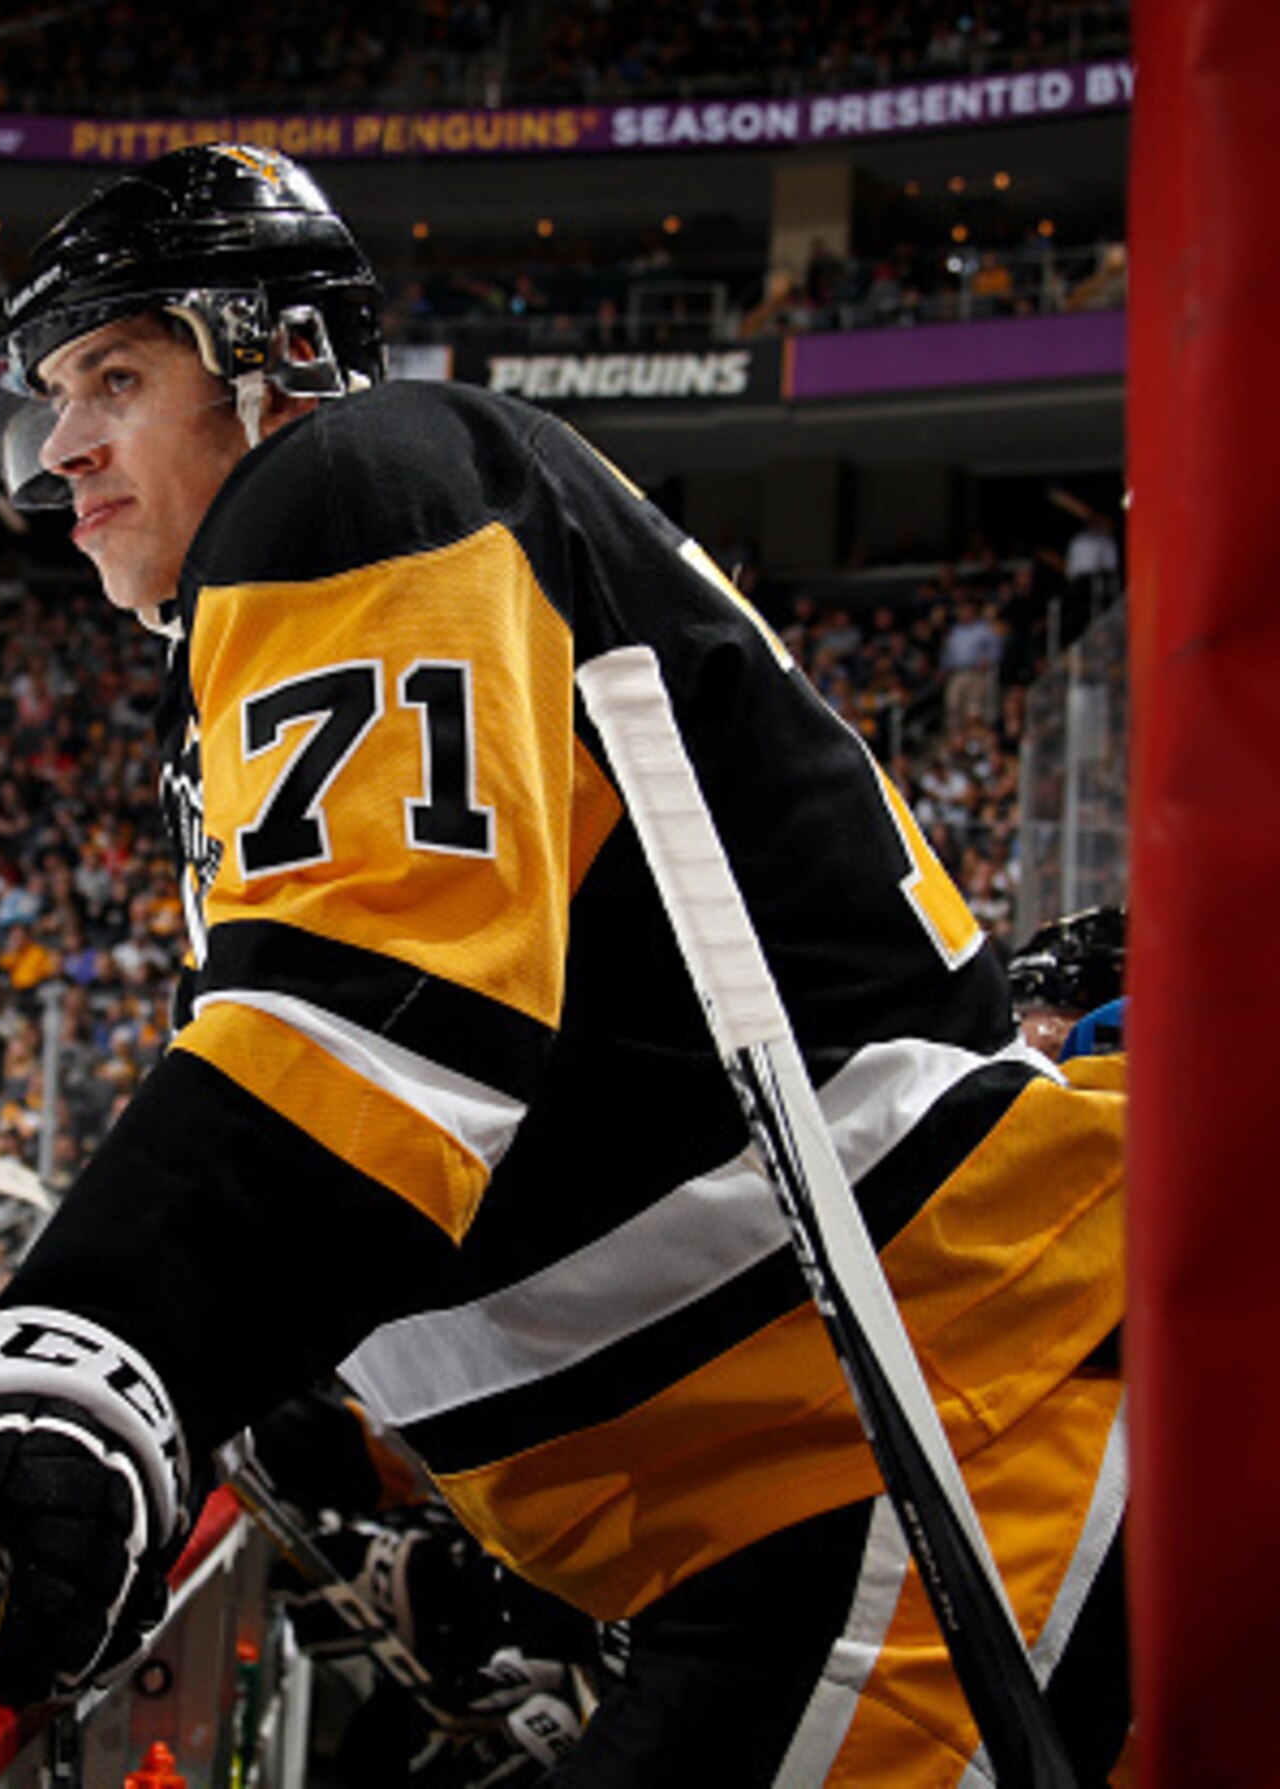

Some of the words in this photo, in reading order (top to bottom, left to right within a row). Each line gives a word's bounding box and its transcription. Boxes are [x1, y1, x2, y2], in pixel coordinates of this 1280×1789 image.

[72, 120, 342, 159] PITTSBURGH
[353, 113, 580, 156] PENGUINS
[612, 101, 799, 146] SEASON
[810, 74, 1074, 137] PRESENTED
[1084, 63, 1140, 105] BY
[488, 351, 751, 400] PENGUINS
[235, 658, 497, 882] 71
